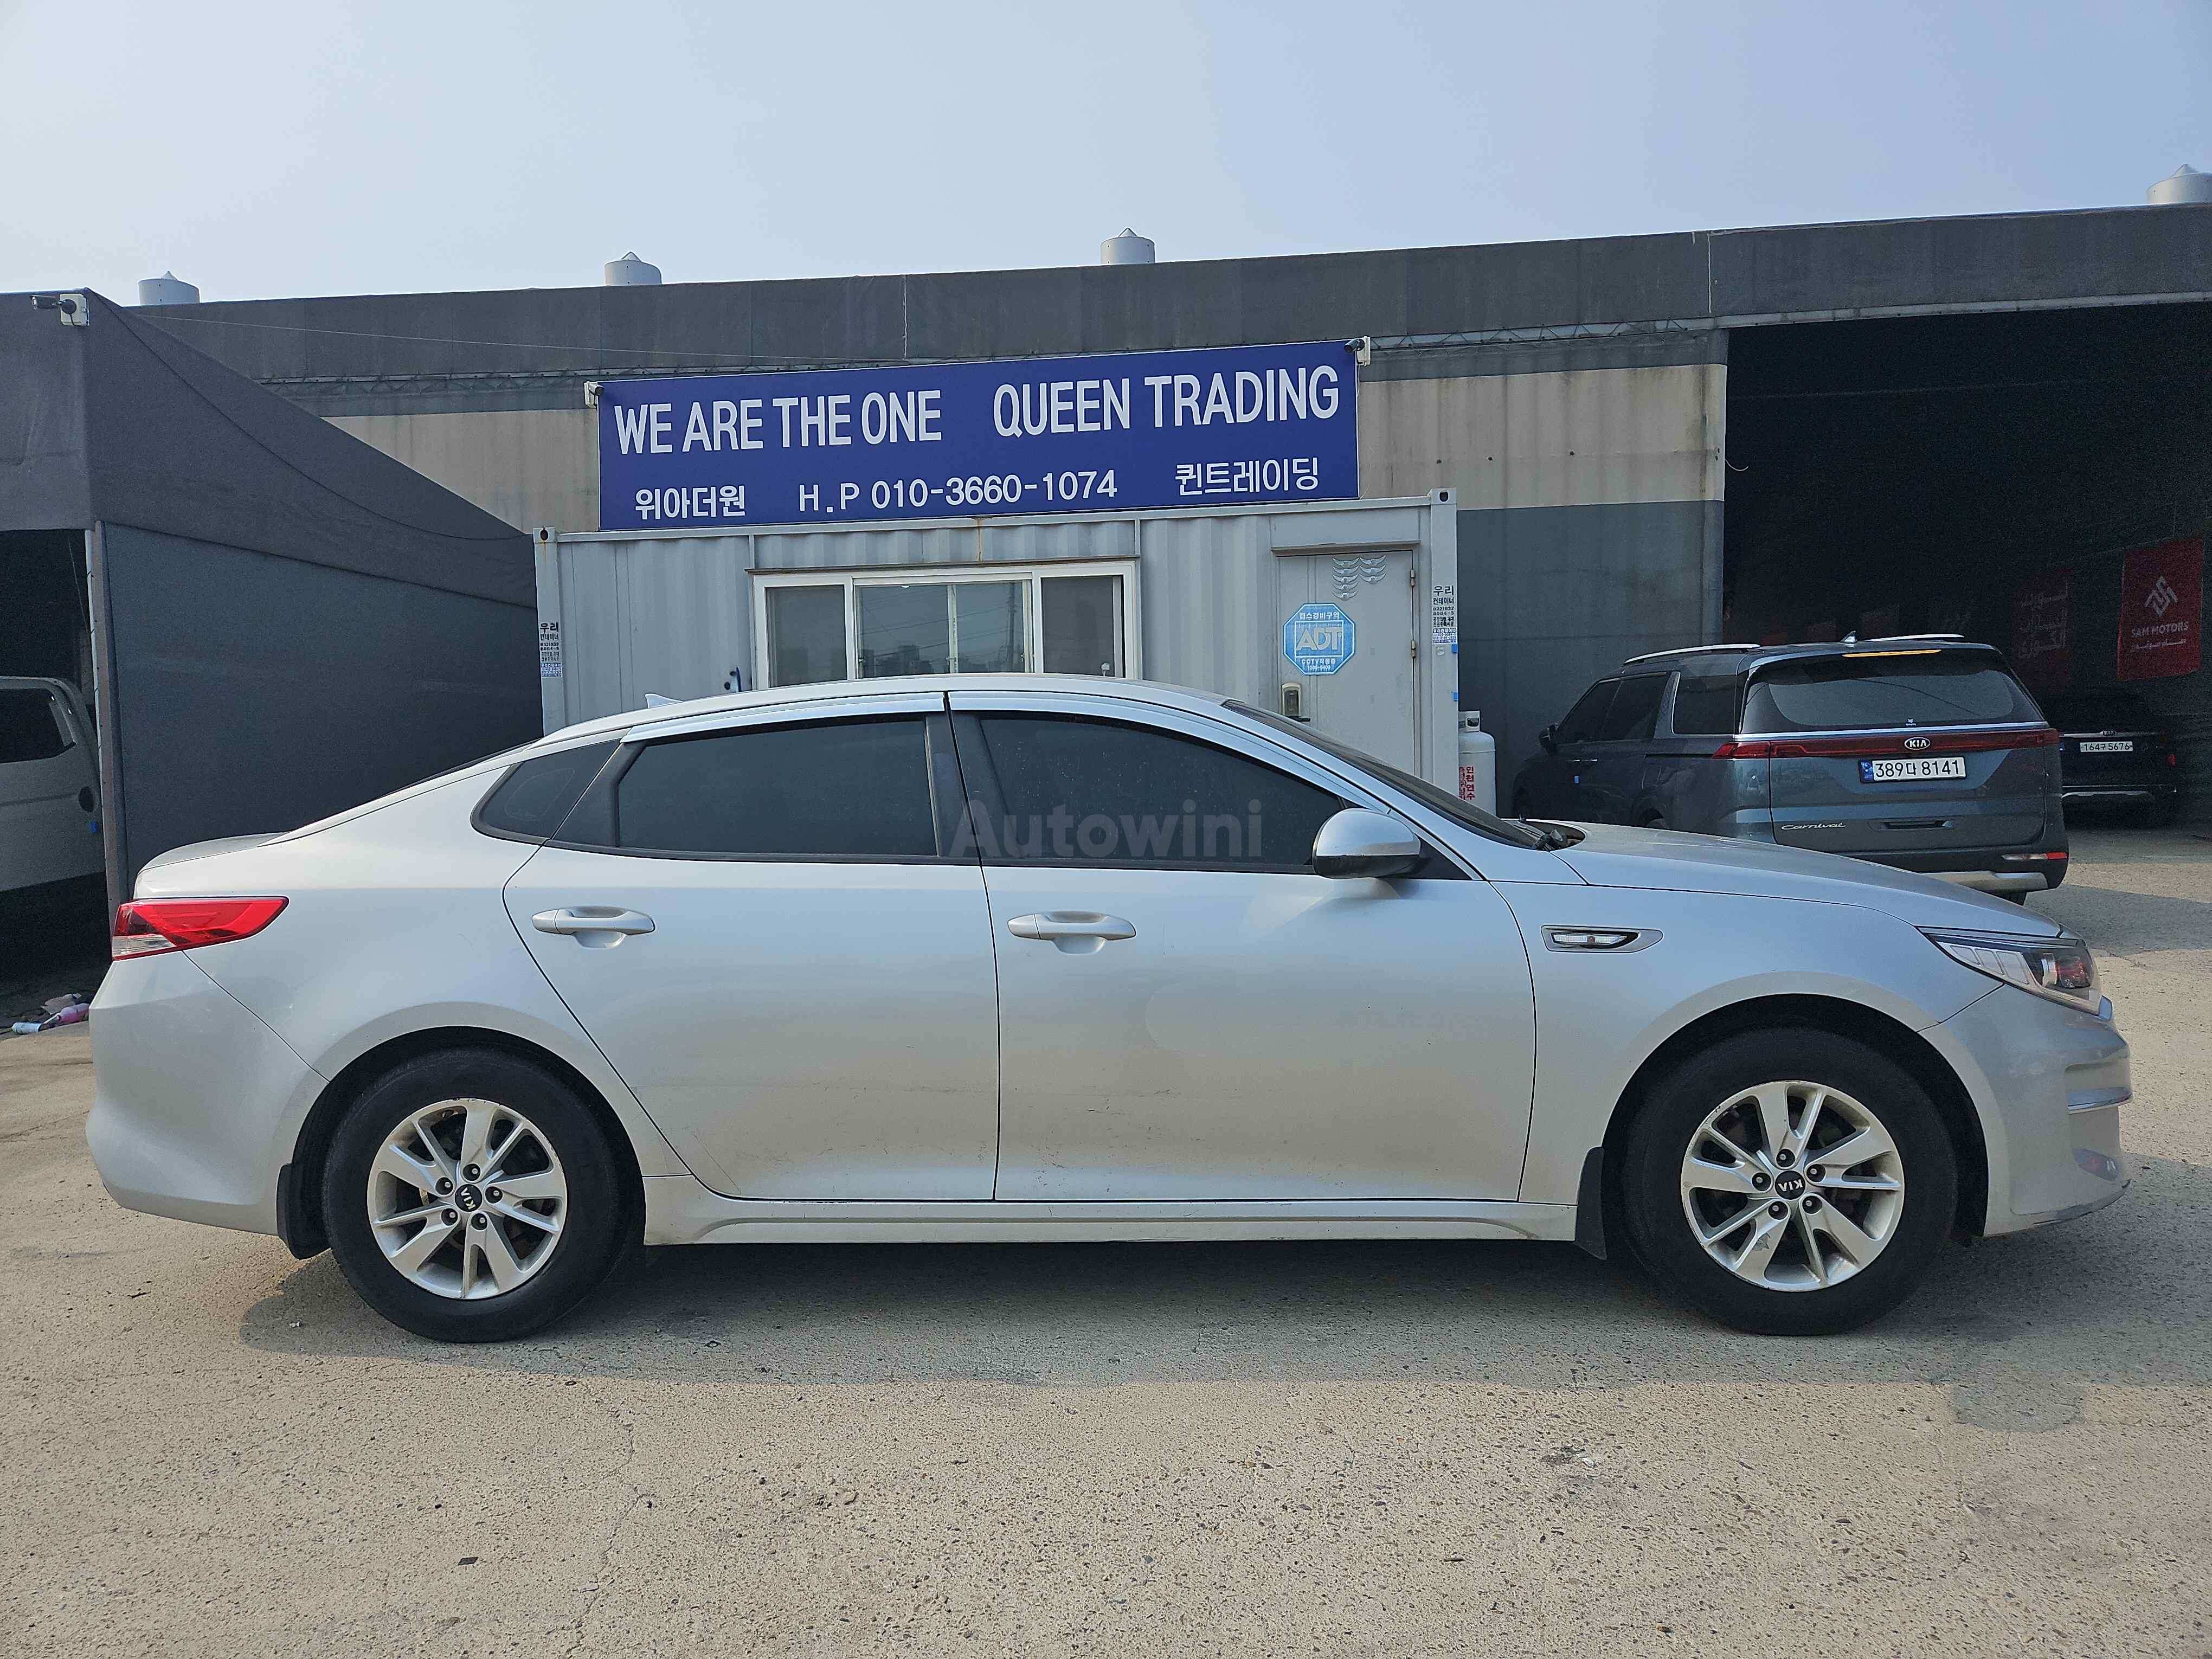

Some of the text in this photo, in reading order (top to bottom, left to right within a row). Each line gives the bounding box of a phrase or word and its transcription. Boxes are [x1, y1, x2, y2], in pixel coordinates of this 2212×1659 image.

[993, 365, 1339, 438] QUEEN TRADING
[614, 390, 942, 455] WE ARE THE ONE
[1175, 457, 1319, 496] 퀸트레이딩
[871, 470, 1117, 510] 010-3660-1074
[635, 485, 745, 520] 위아더원
[1433, 585, 1454, 596] 우리
[1433, 597, 1454, 605] 컨테이너
[539, 622, 558, 634] 우리
[1296, 627, 1343, 651] ADT
[2108, 742, 2130, 750] 5676
[1875, 760, 1959, 777] 389다 8141
[1781, 821, 1847, 831] Carnival
[1778, 1179, 1804, 1192] KIA
[460, 1187, 476, 1210] KIA
